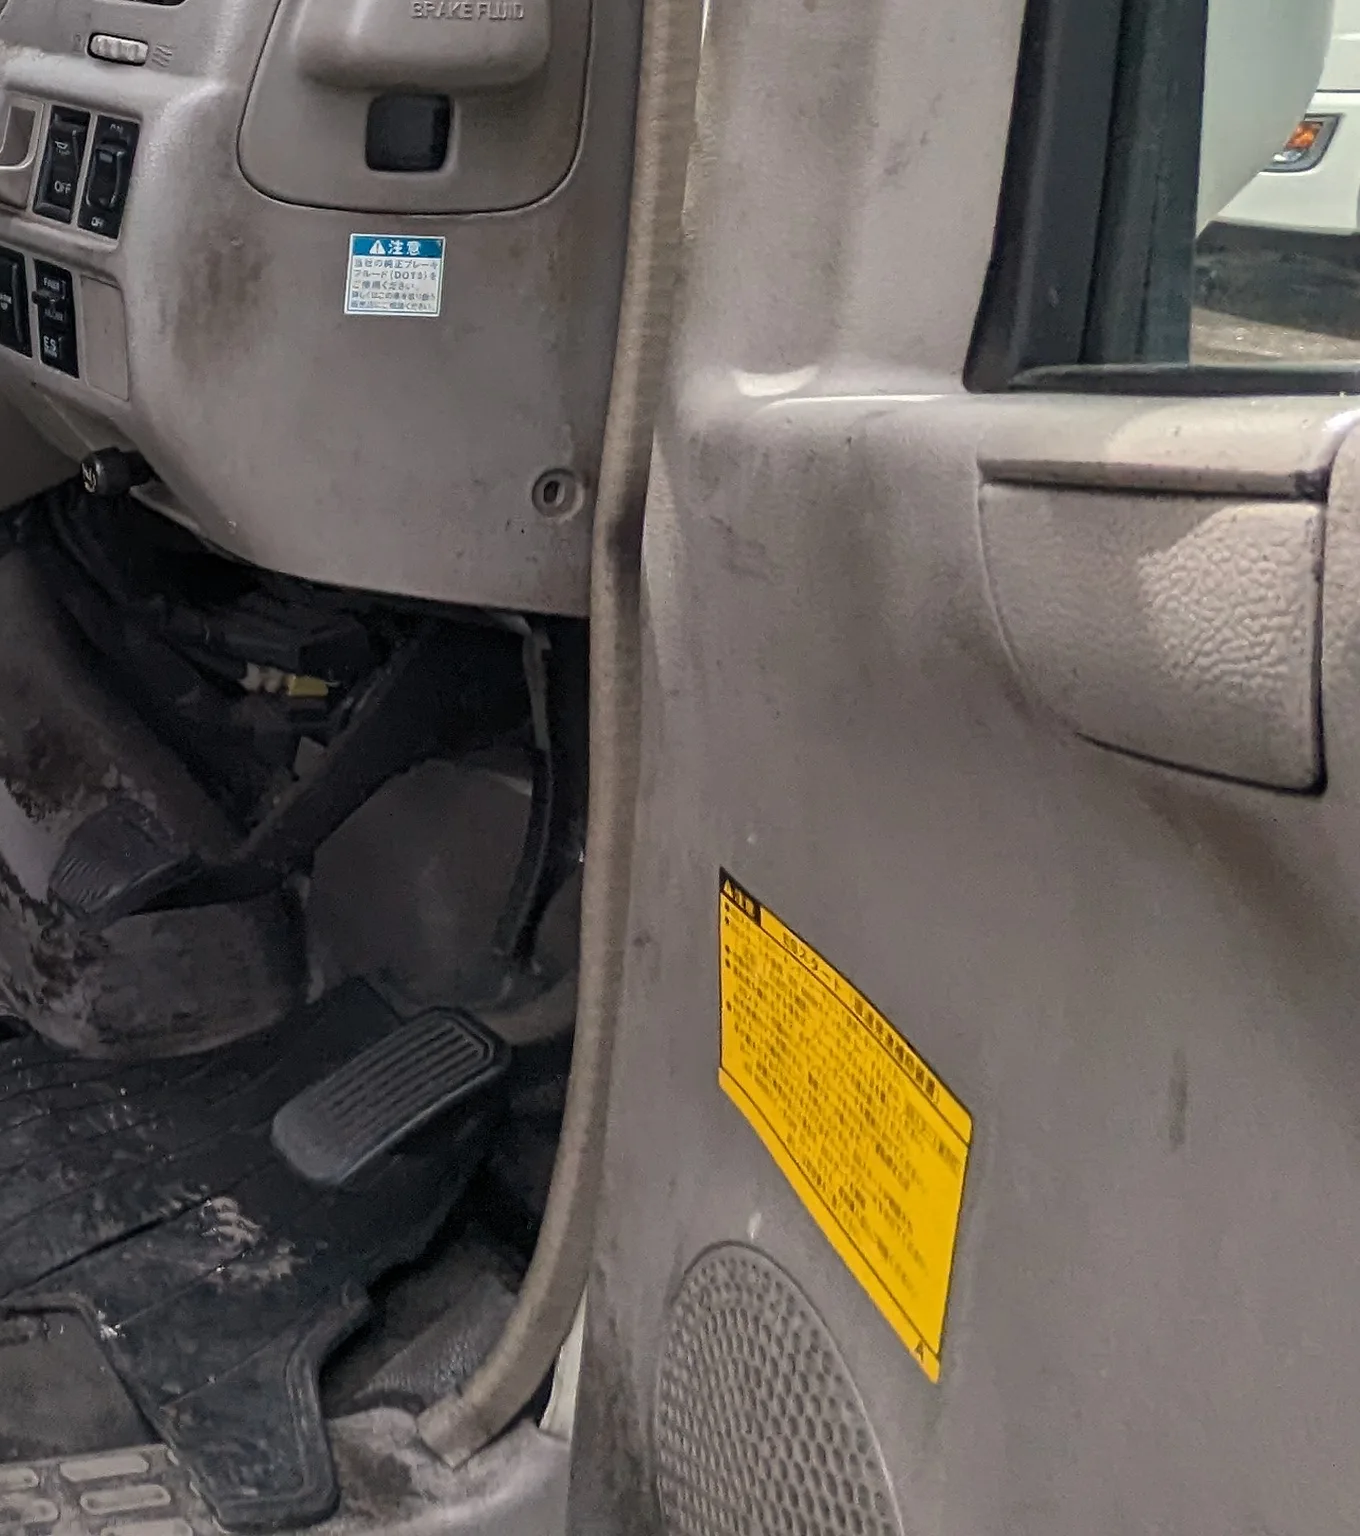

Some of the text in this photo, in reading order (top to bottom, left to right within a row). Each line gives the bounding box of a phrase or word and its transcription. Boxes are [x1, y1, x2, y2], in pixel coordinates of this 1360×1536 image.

[411, 0, 526, 21] BRAKE FLUID
[54, 180, 72, 195] OFF
[388, 239, 421, 256] 注意
